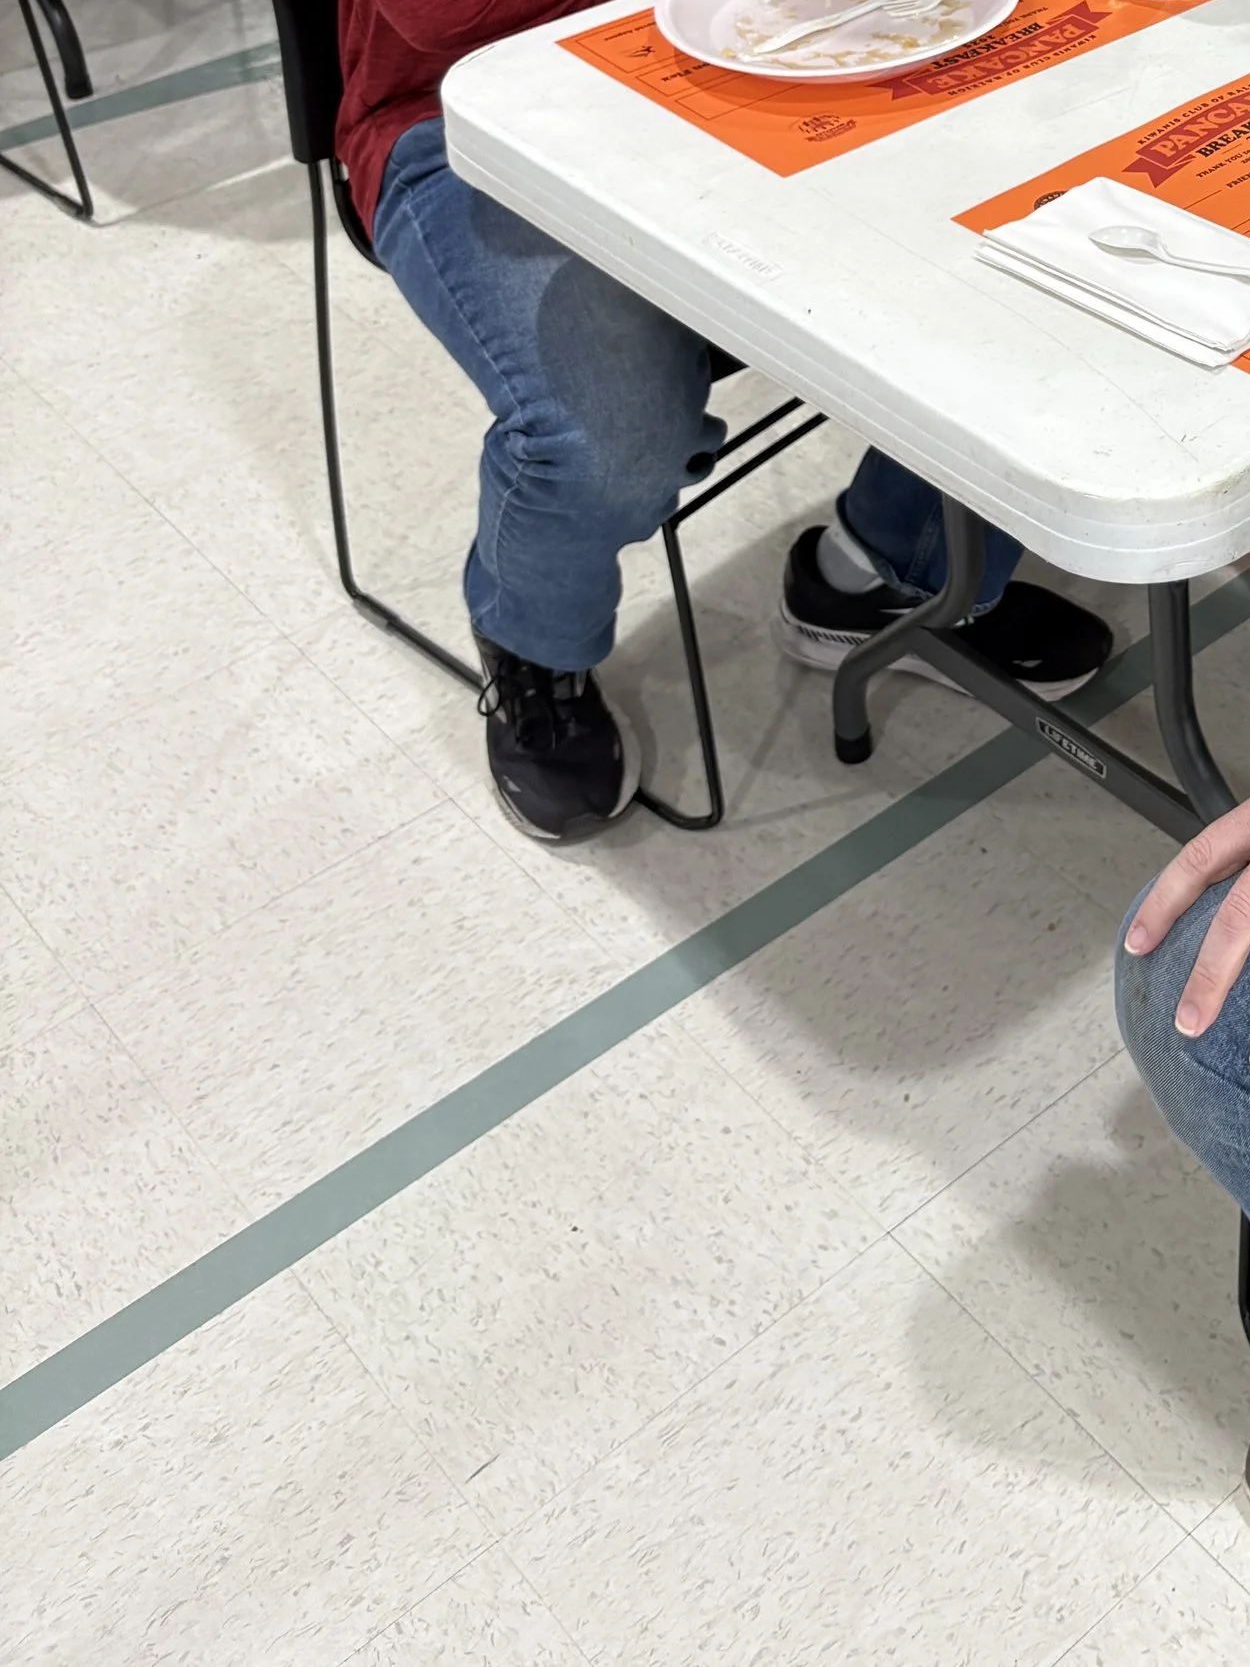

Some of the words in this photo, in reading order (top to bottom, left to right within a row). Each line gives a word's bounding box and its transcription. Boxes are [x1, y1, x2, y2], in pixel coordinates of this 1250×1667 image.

[927, 24, 1083, 88] PANCAKE
[931, 22, 1042, 69] BREAKFAST
[1053, 34, 1096, 57] KIWANIS
[1006, 69, 1020, 77] OF
[1022, 54, 1052, 70] CLUB
[948, 74, 1002, 95] RALEIGH
[1138, 118, 1180, 143] KIWANIS
[1181, 103, 1210, 116] CLUB
[1210, 94, 1226, 103] OF
[1196, 162, 1226, 176] THANK
[1225, 152, 1243, 162] YOU
